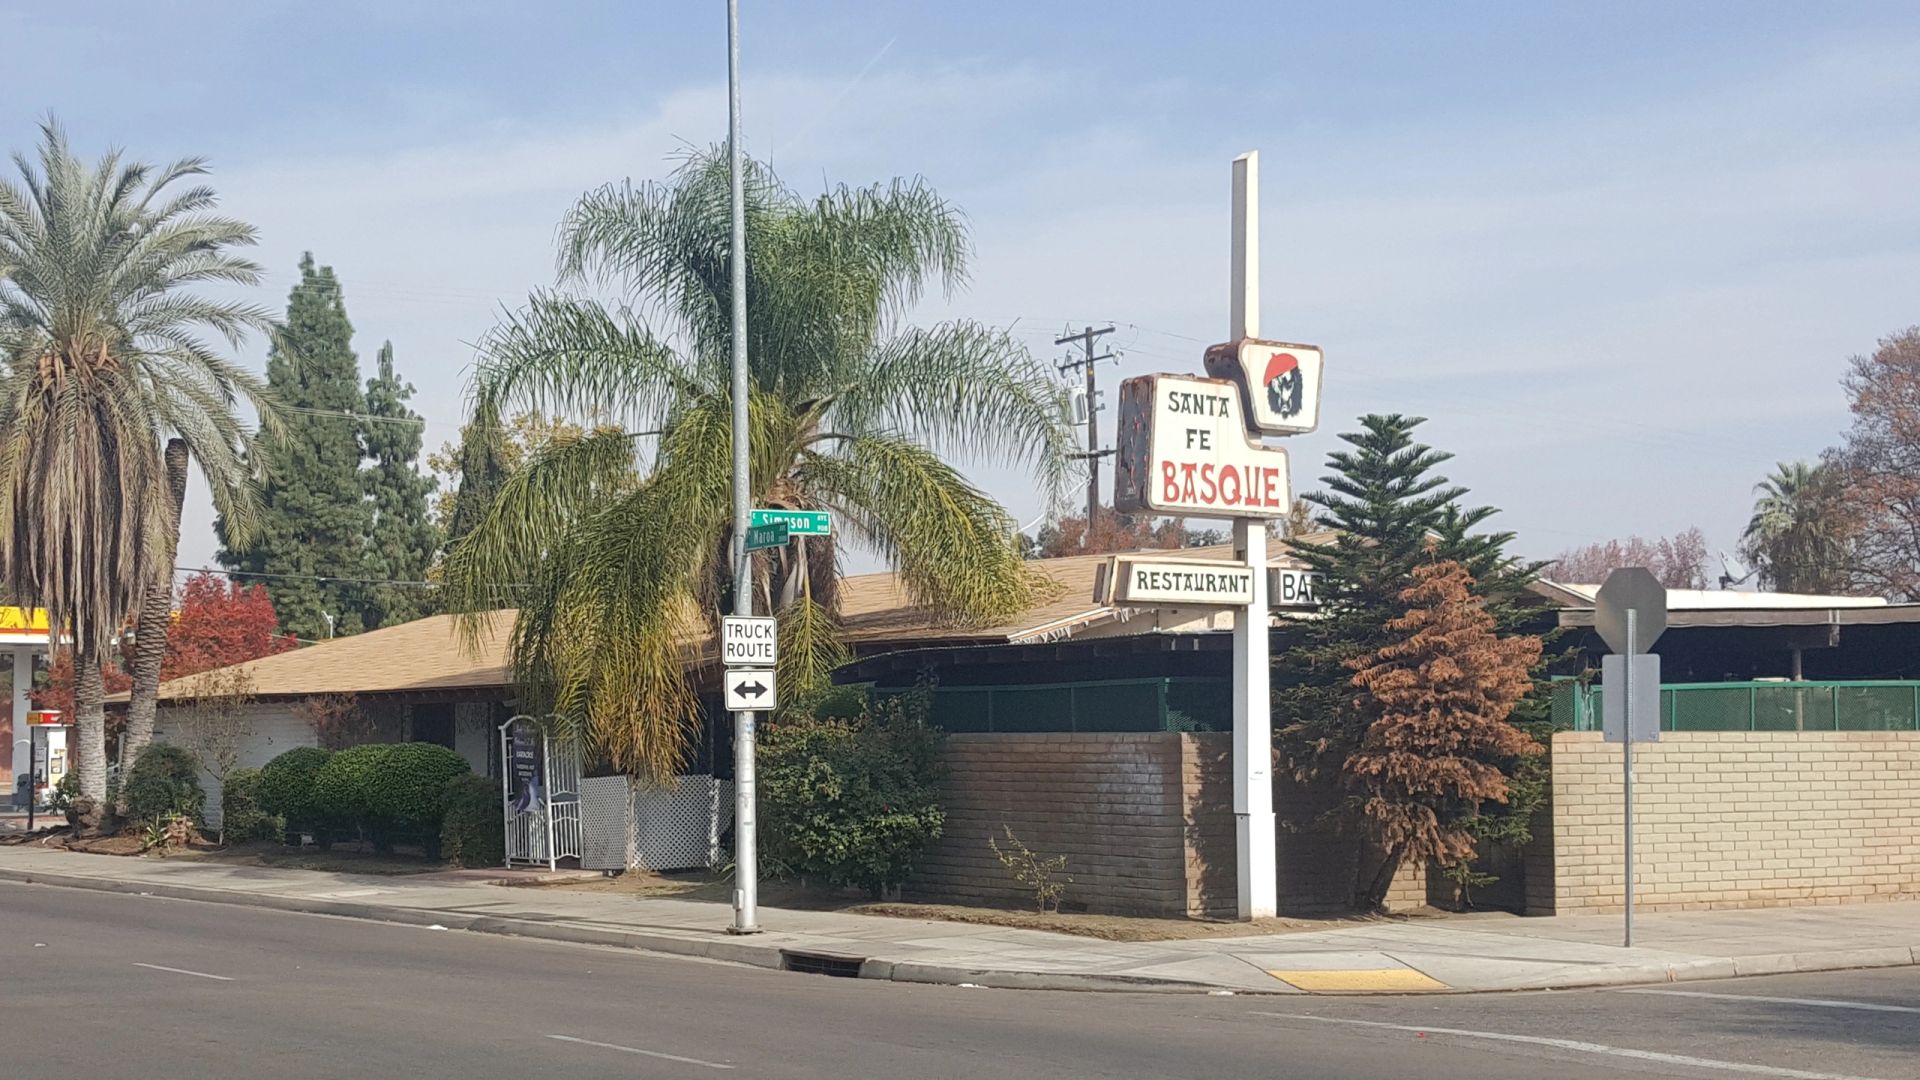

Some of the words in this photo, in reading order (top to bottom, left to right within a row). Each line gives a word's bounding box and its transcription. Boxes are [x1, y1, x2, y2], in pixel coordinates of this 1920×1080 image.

[1168, 391, 1230, 418] SANTA
[1186, 428, 1211, 450] FE
[1162, 460, 1279, 507] BASQUE
[753, 529, 775, 544] Maroa
[1136, 570, 1249, 594] RESTAURANT
[727, 623, 773, 639] TRUCK
[727, 642, 773, 658] ROUTE
